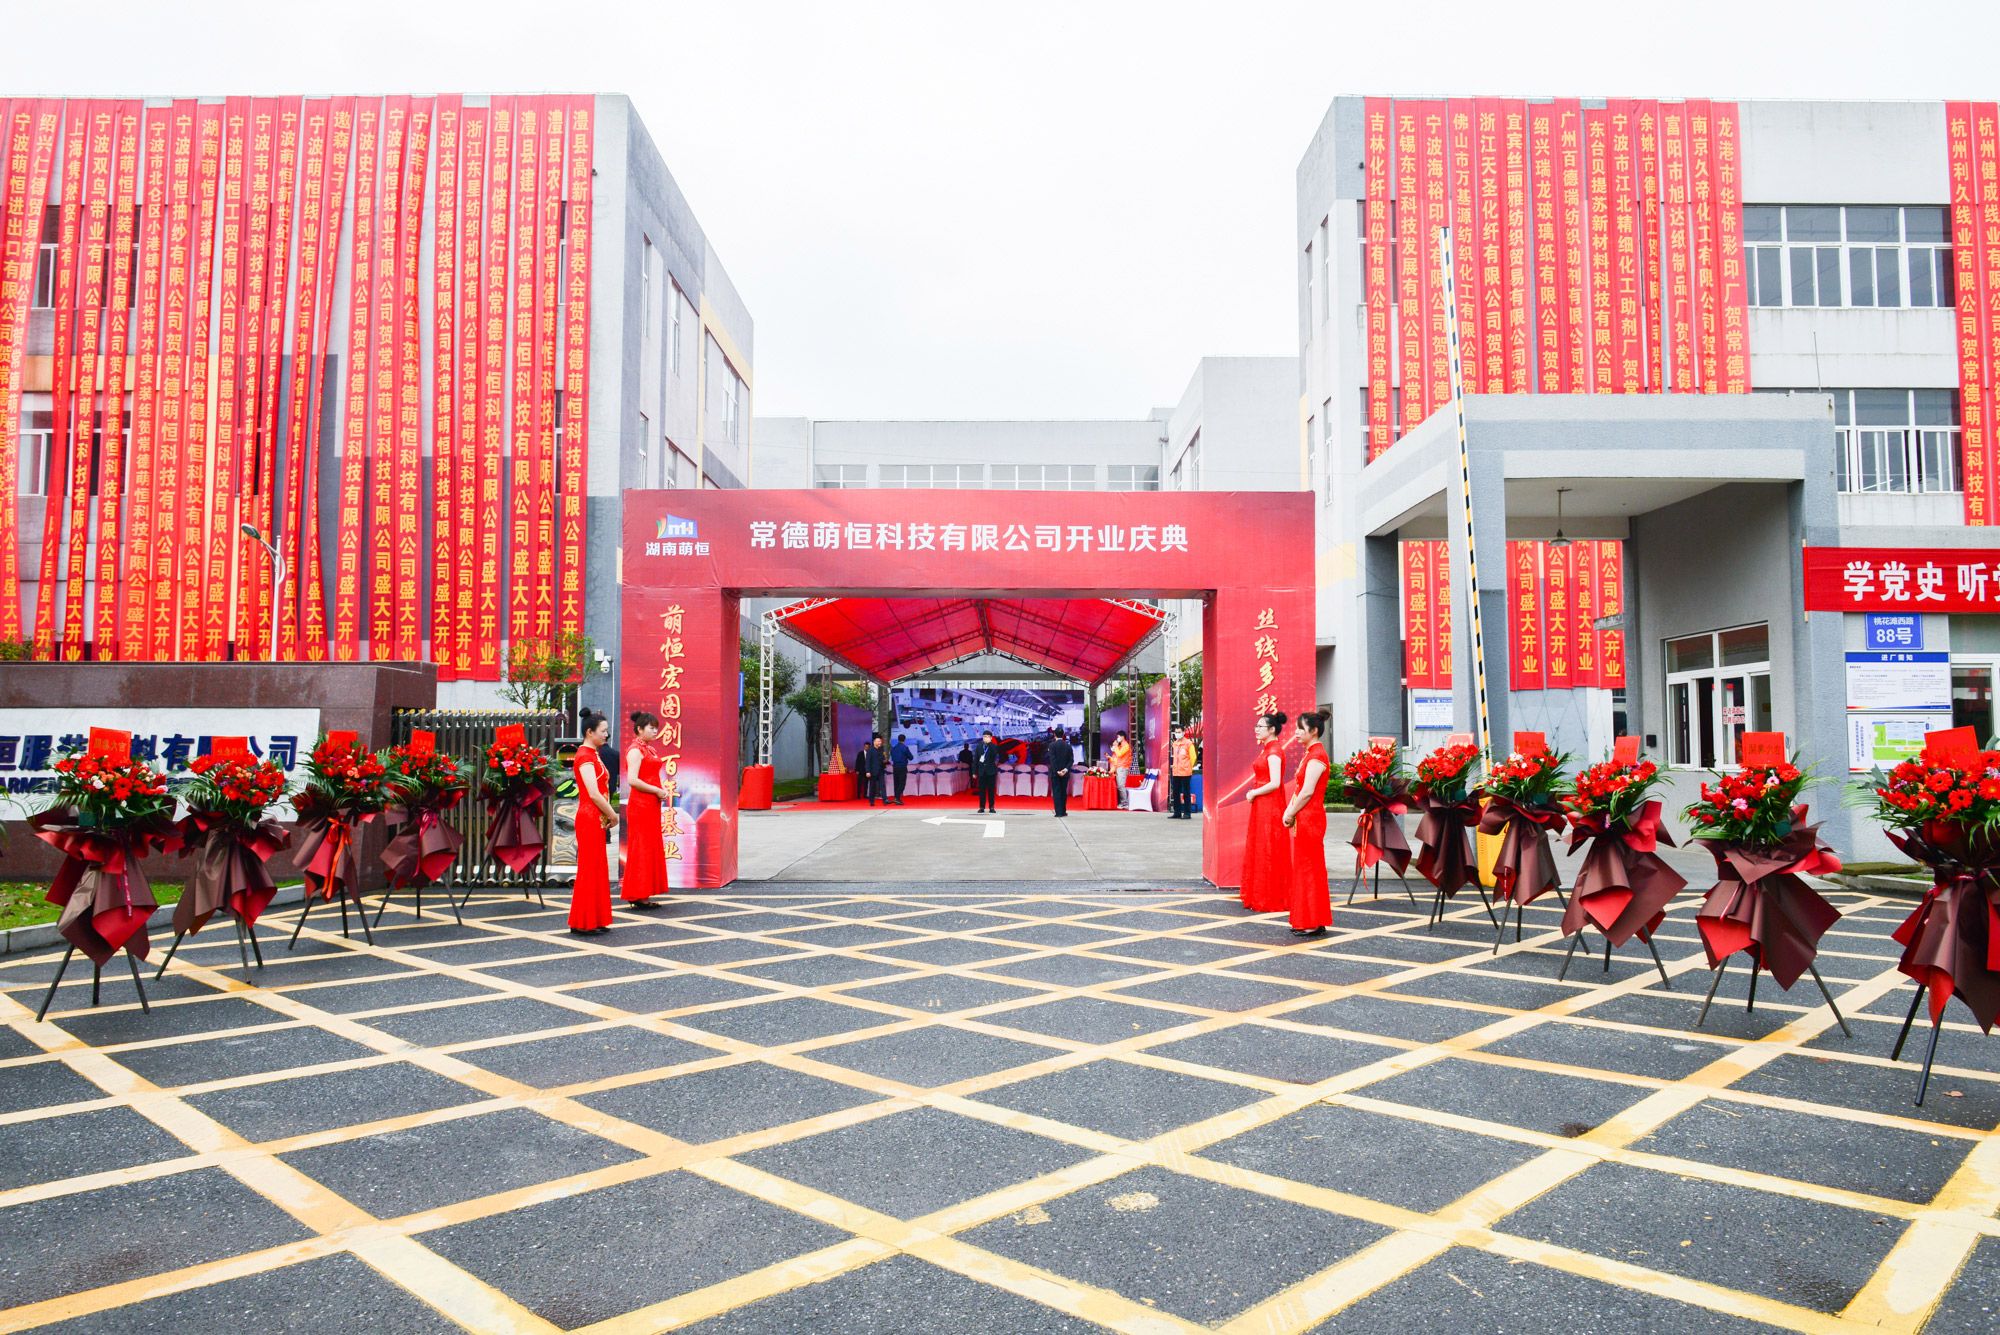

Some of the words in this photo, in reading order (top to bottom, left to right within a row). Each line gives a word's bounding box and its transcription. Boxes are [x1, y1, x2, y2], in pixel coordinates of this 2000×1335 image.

[645, 541, 711, 557] 湖南萌恒
[750, 521, 1189, 553] 常德萌恒科技有限公司开业庆典
[1843, 561, 1947, 602] 学党史
[1957, 562, 2000, 602] 听
[1876, 627, 1913, 645] 88号
[1253, 607, 1279, 716] 丝线多彩
